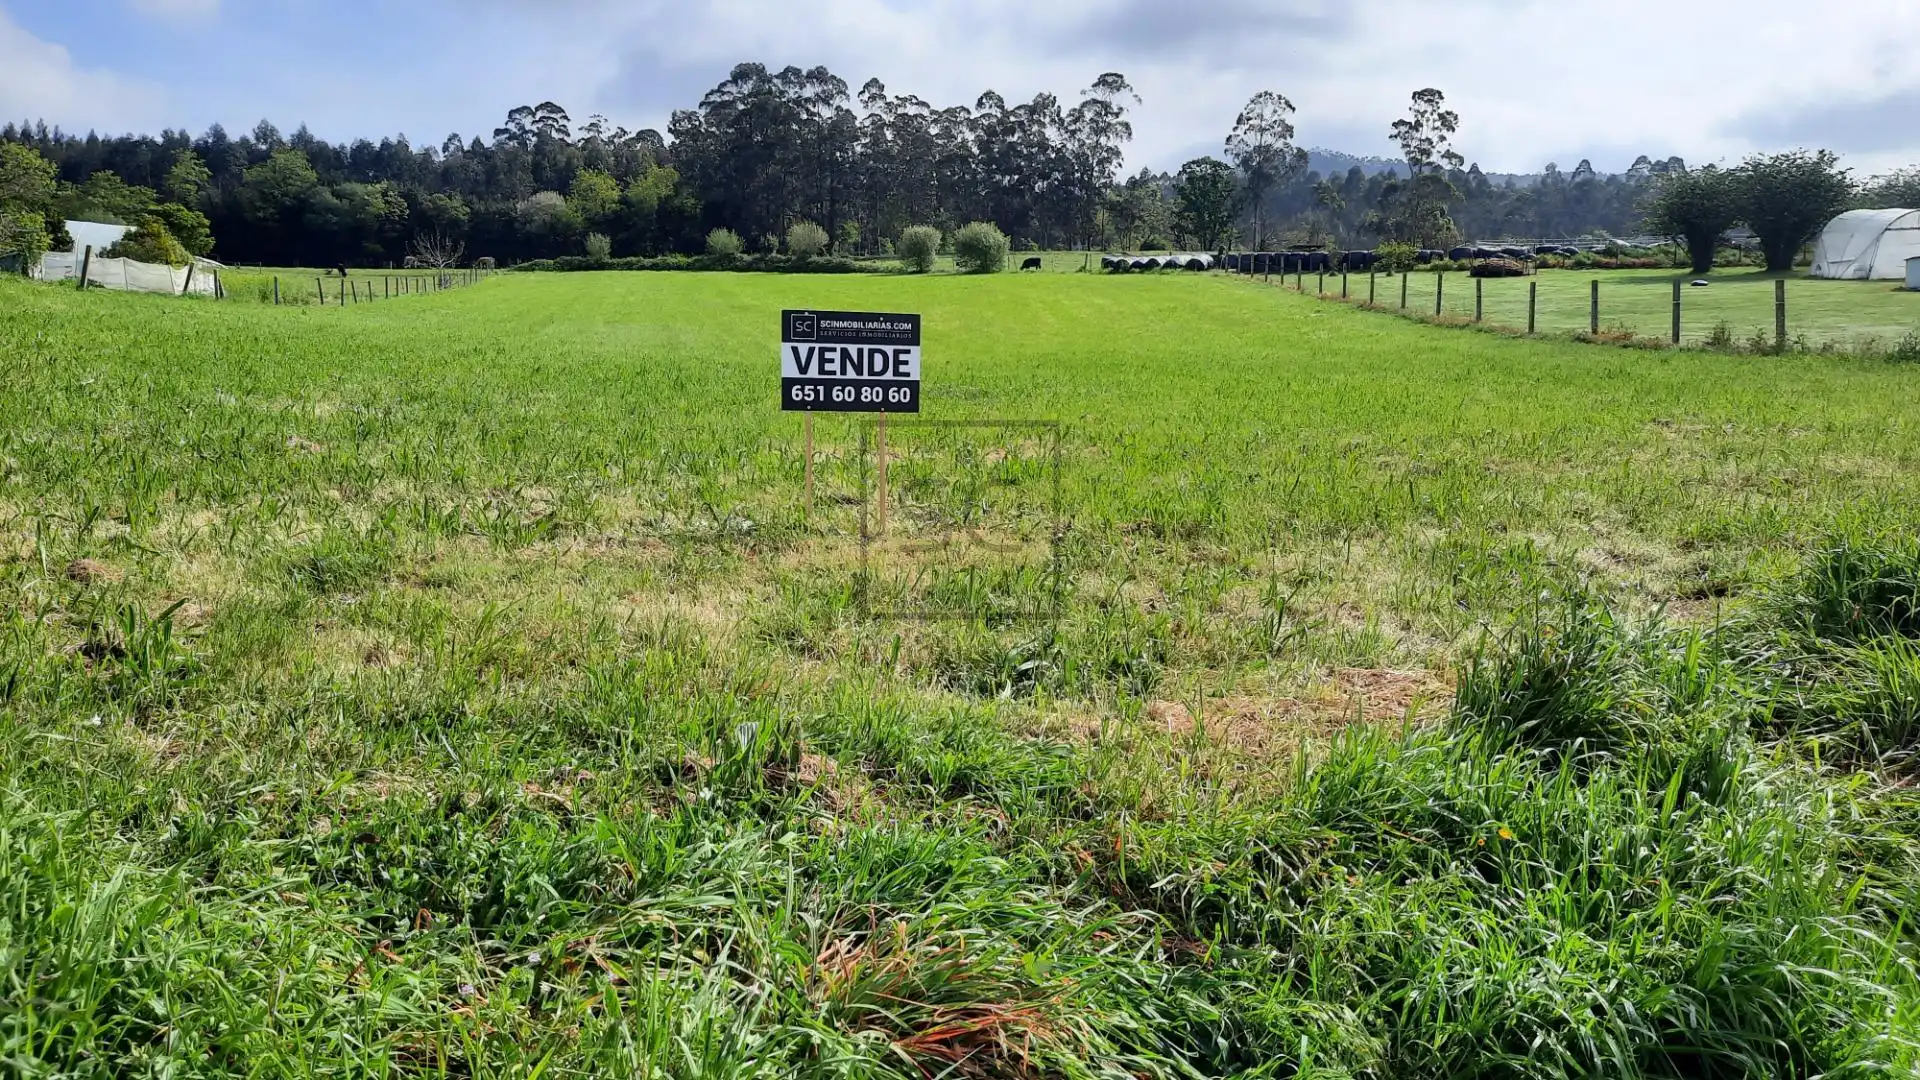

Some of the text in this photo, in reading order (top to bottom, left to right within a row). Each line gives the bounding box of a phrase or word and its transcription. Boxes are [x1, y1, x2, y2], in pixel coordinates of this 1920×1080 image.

[795, 321, 812, 332] SC
[820, 320, 912, 331] SCINMOBILIARIAS.COM
[790, 345, 912, 378] VENDE
[791, 385, 911, 403] 651 60 80 60
